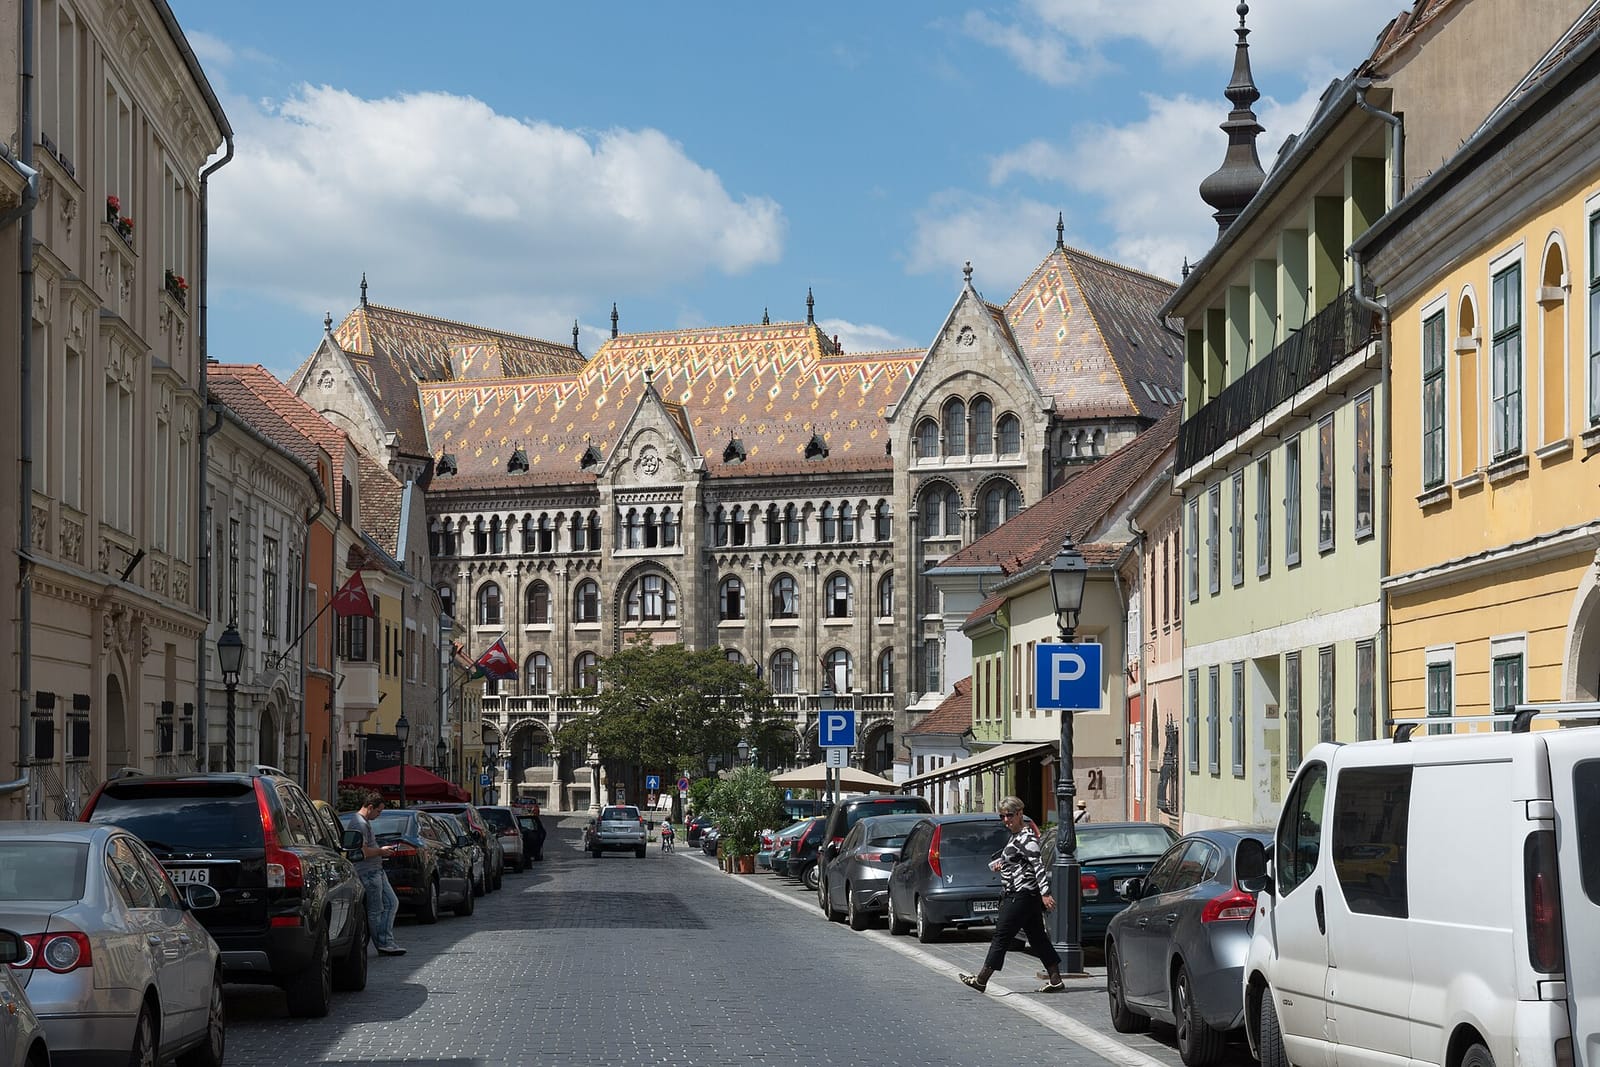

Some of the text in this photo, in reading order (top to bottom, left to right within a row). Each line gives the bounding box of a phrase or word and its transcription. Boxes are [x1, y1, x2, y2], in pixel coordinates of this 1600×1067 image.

[1051, 653, 1086, 700] P
[828, 715, 847, 741] P
[481, 775, 489, 784] P
[1088, 769, 1103, 790] 21
